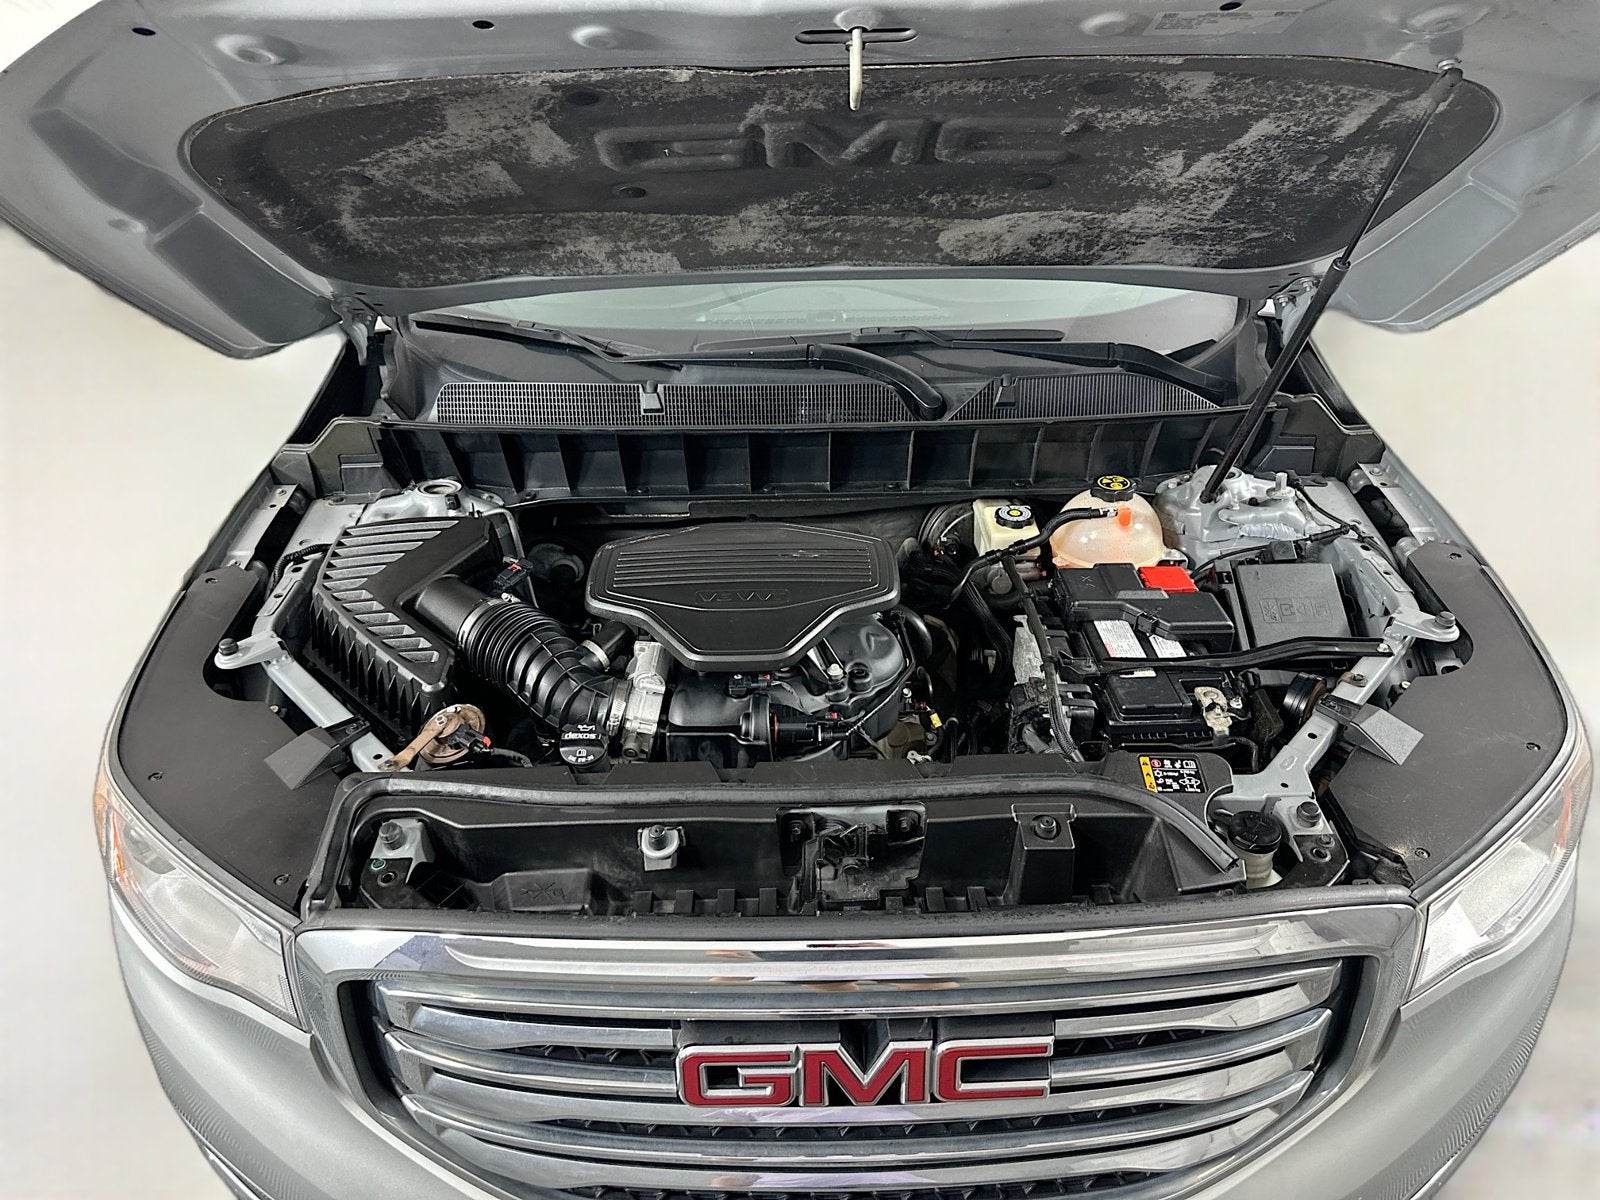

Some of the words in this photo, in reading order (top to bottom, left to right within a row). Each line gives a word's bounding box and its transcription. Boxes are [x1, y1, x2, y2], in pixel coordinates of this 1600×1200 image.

[595, 117, 1073, 173] GMC
[564, 731, 597, 740] dexos
[677, 1035, 1054, 1108] GMC
